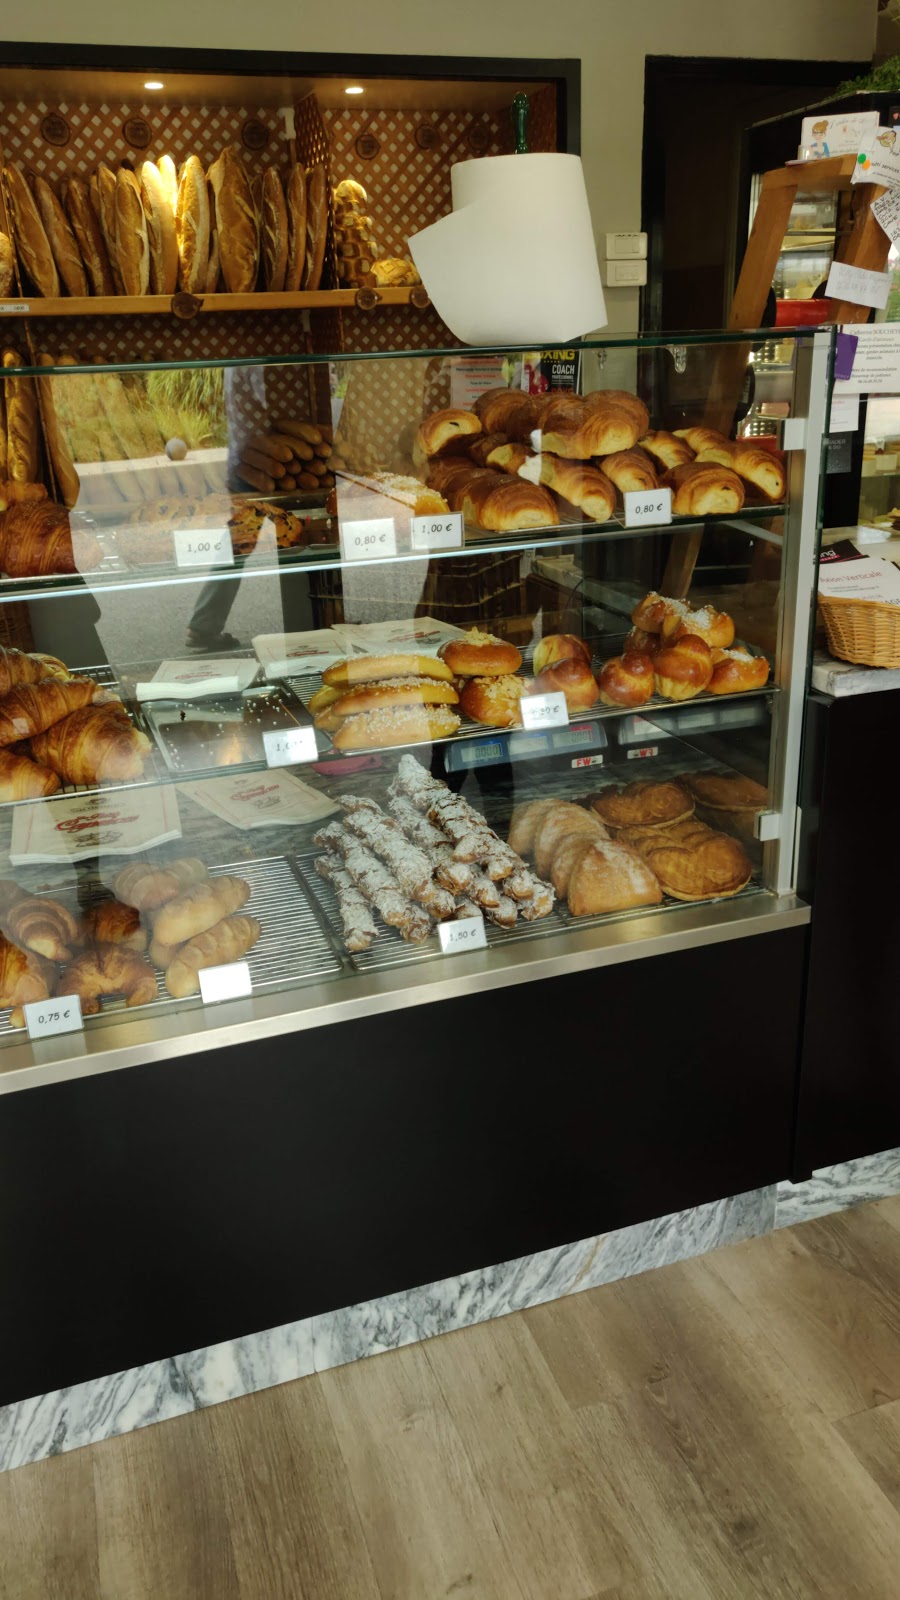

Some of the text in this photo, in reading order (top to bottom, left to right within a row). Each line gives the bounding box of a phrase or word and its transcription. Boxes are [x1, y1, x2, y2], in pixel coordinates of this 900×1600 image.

[552, 364, 575, 375] COACH
[635, 503, 663, 515] 0,80 €
[421, 523, 453, 535] 1,00 €
[354, 534, 387, 547] 0,80 €
[187, 542, 221, 553] 1,00 €
[843, 571, 883, 581] Verticale
[450, 929, 477, 942] 1,50 €
[38, 1009, 71, 1025] 0,75 €
